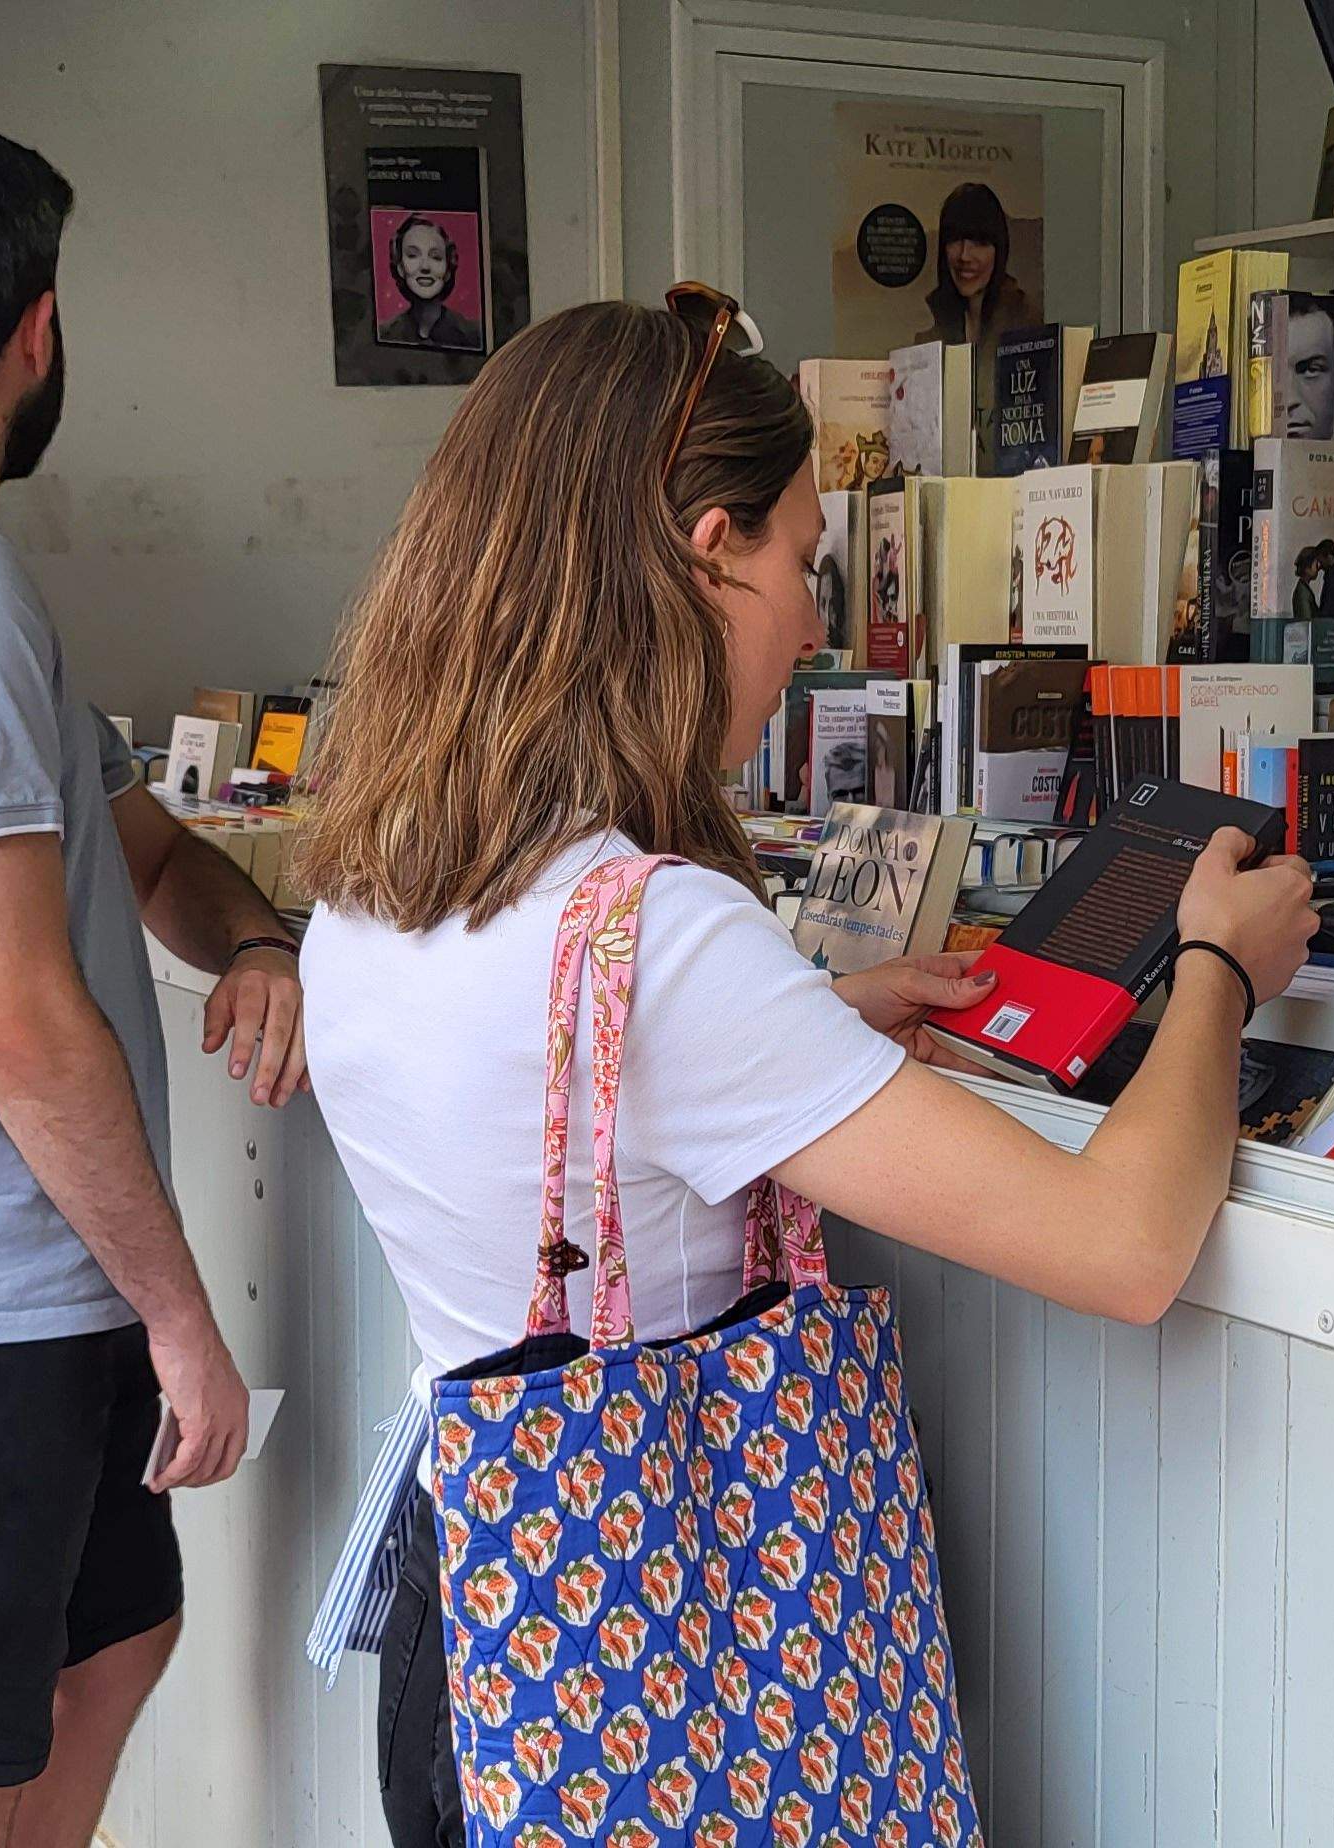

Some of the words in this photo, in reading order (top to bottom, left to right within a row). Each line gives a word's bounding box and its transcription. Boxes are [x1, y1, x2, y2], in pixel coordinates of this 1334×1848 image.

[865, 133, 916, 158] KATE
[924, 137, 1013, 161] MORTON
[1010, 371, 1037, 394] LUZ
[1001, 405, 1032, 422] NOCHE
[1032, 403, 1045, 419] DE
[1000, 418, 1046, 448] ROMA
[1049, 486, 1083, 501] NAVARRO
[1046, 610, 1080, 622] HISTORIA
[1033, 625, 1077, 637] COMPARTIDA
[995, 650, 1026, 659] KIRSTEN
[1027, 650, 1056, 659] THORUP
[1190, 684, 1279, 697] CONSTRUYENDO
[1190, 696, 1219, 708] BABEL
[835, 824, 898, 862] DONNA
[809, 852, 917, 916] LEON
[843, 918, 904, 943] tempestades
